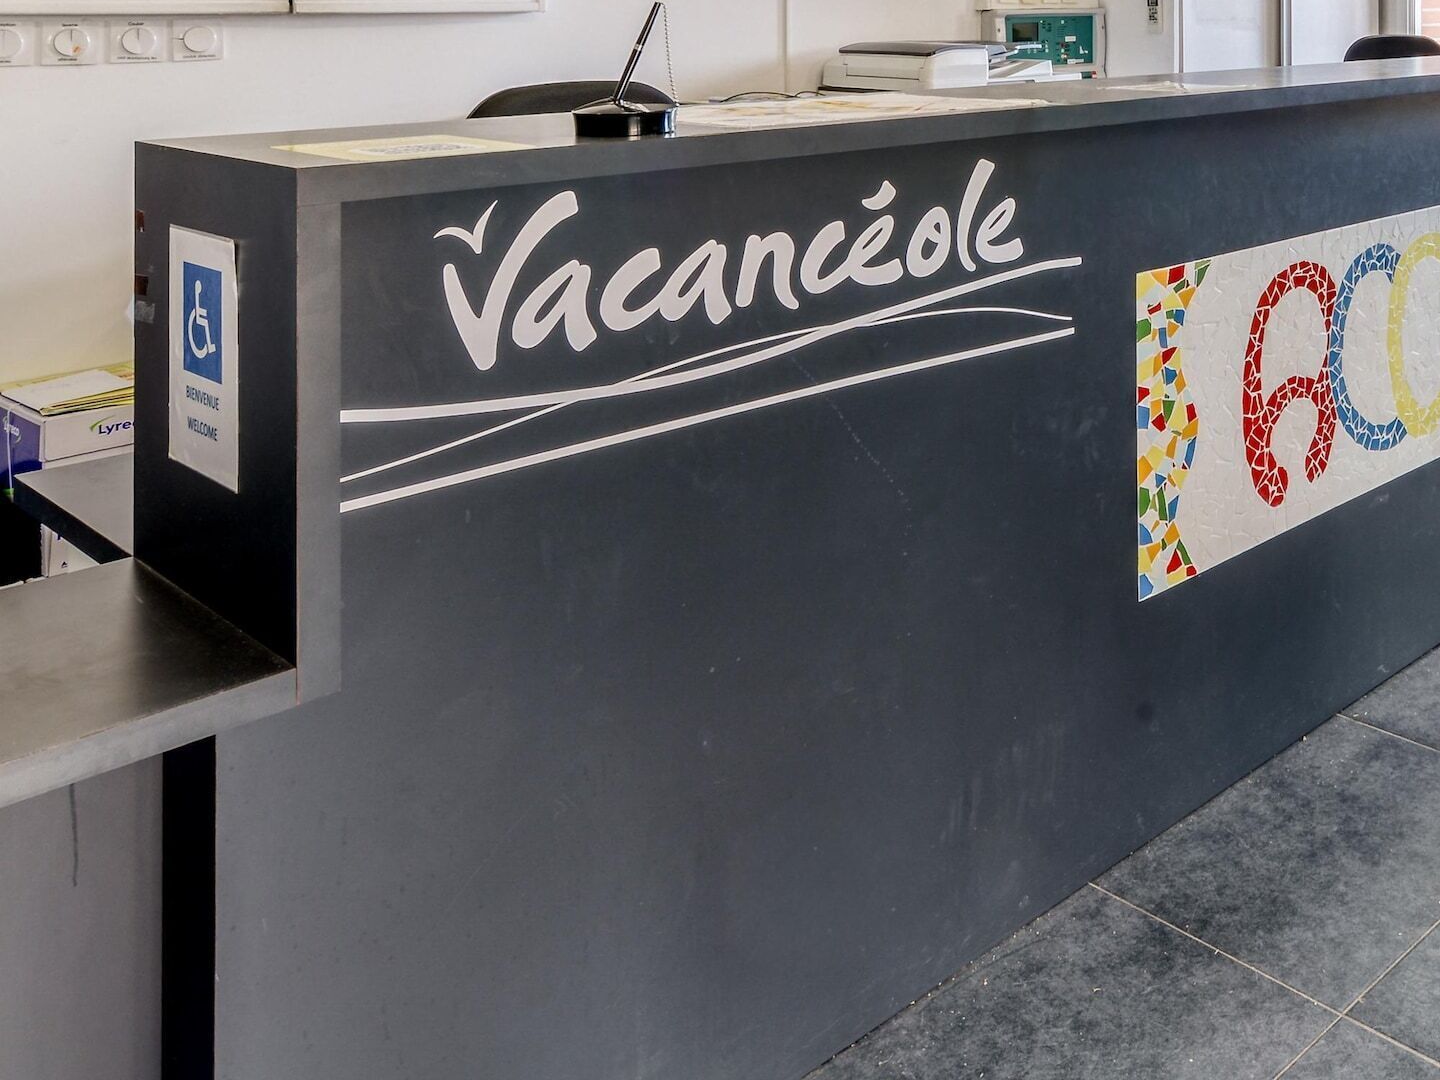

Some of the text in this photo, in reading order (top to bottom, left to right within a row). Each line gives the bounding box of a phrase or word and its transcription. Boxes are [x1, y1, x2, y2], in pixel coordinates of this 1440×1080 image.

[443, 158, 1024, 371] Vacancéole
[186, 385, 219, 411] BIENVENUE
[99, 420, 135, 435] Lyre
[187, 416, 217, 441] WELCOME
